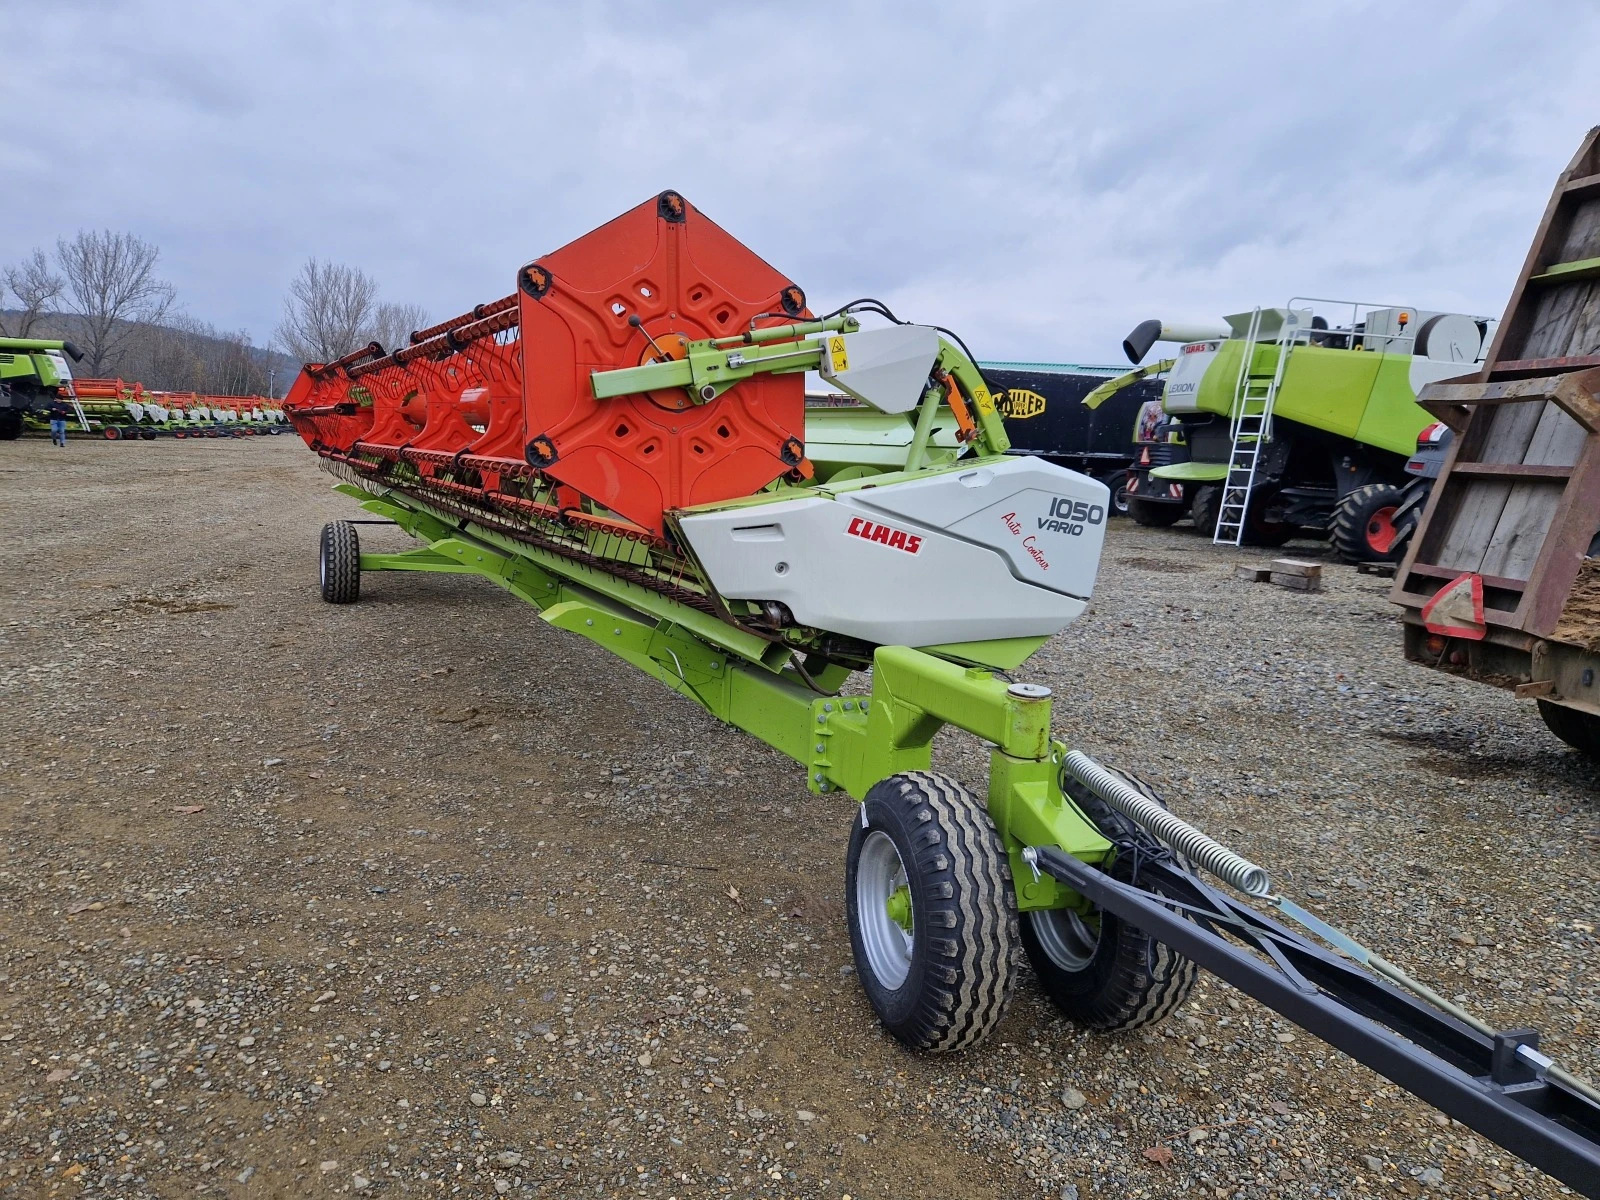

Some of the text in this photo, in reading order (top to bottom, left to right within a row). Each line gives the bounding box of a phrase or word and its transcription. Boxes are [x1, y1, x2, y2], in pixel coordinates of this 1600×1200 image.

[1185, 344, 1206, 354] CLAAS
[1168, 382, 1195, 393] LEXION
[1049, 497, 1104, 525] 1050
[847, 517, 922, 553] CLAAS
[1037, 517, 1084, 536] VARIO
[1001, 512, 1050, 570] Auto Contour
